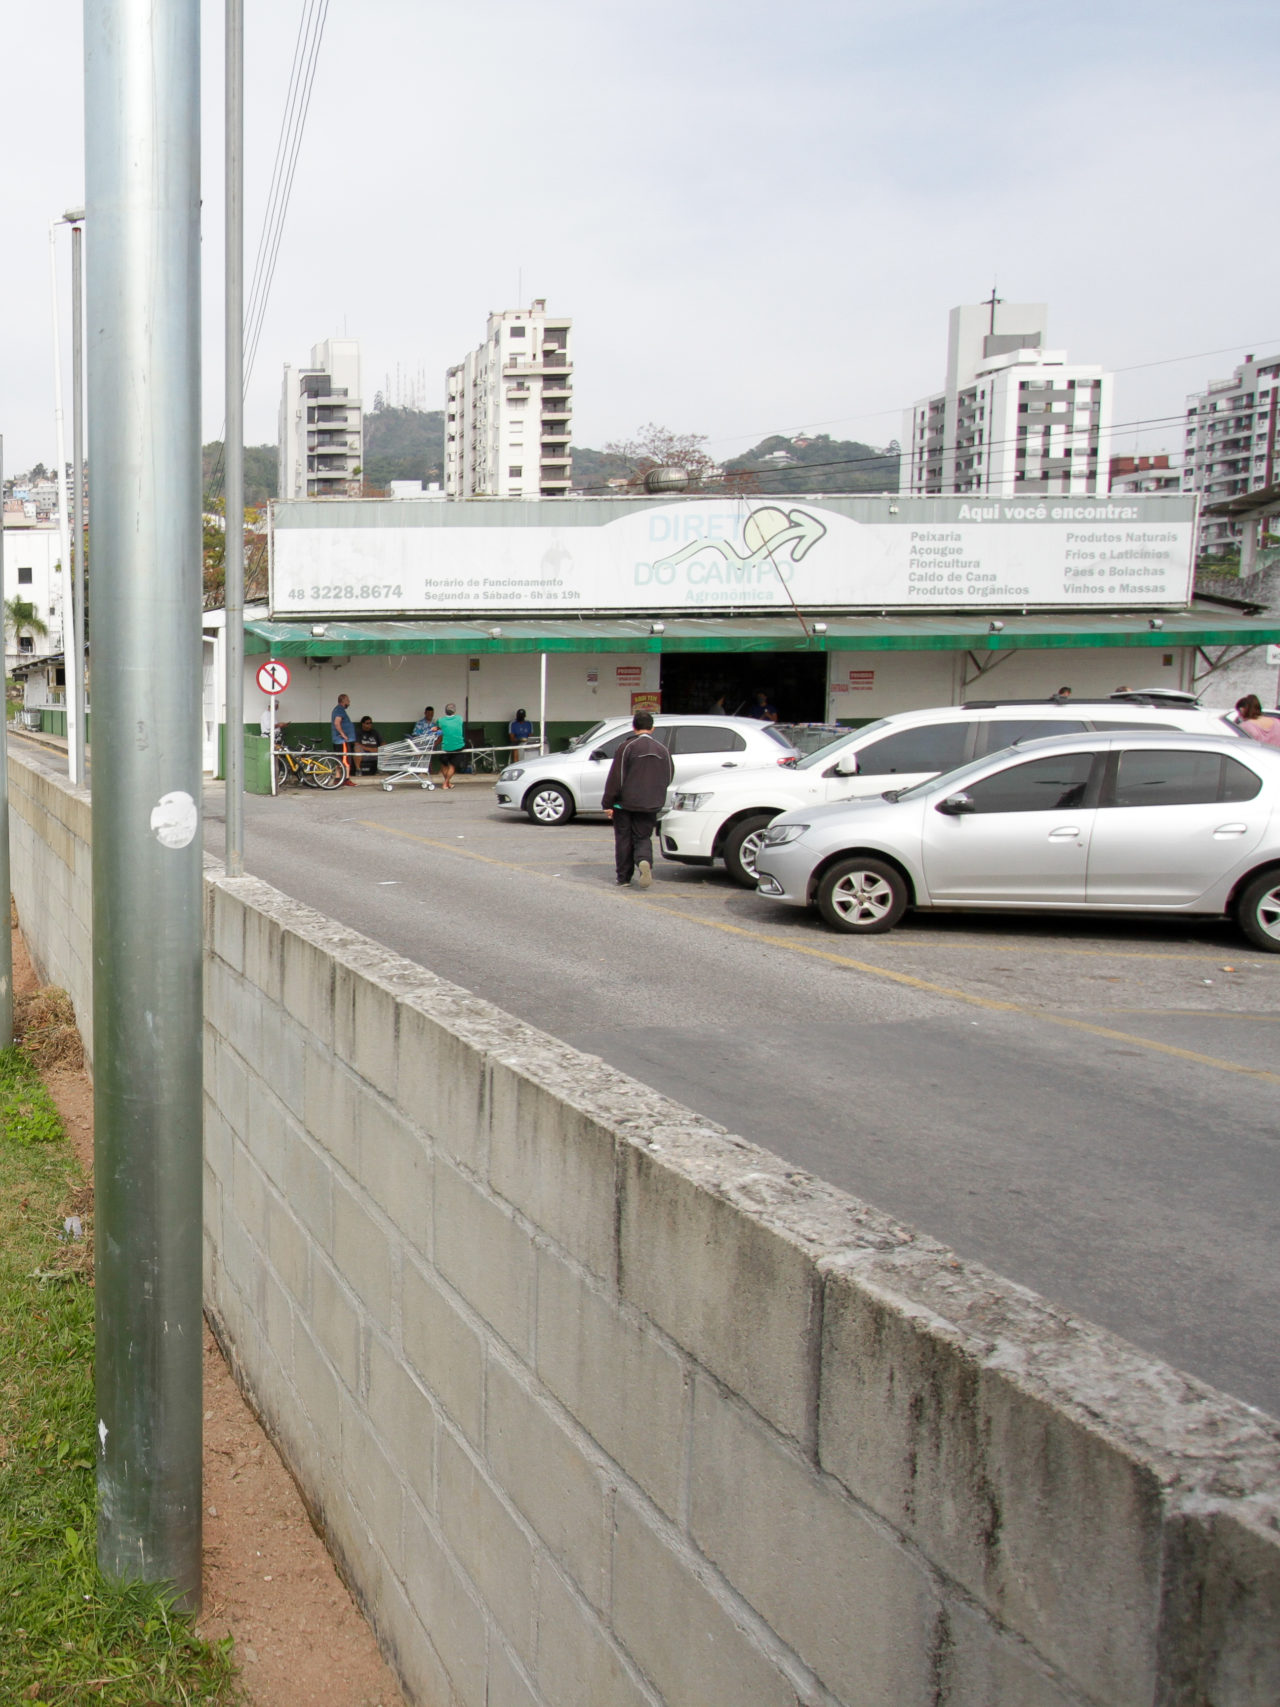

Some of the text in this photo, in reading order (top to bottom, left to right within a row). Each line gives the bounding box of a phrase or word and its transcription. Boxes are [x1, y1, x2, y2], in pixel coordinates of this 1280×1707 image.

[958, 503, 1138, 521] Aqui você encontra:
[911, 531, 962, 542] Peixaria
[1066, 532, 1178, 543] Produtos Naturais
[910, 545, 964, 557] Açougue
[1065, 549, 1096, 560] Frios
[909, 559, 980, 568] Floricultura
[634, 560, 794, 586] DO CAMPO
[1064, 566, 1094, 576] Pães
[1109, 566, 1165, 576] Bolachas
[908, 572, 997, 582] Caldo de Cana
[424, 578, 563, 588] Horário de Funcionamento
[1063, 583, 1166, 594] Vinhos e Massas
[288, 585, 403, 600] 48 3228.8674
[424, 591, 470, 602] Segunda
[482, 591, 521, 600] Sábado
[530, 591, 543, 600] 6h
[562, 591, 580, 599] 19h
[685, 589, 774, 603] Agronômica
[908, 585, 1030, 597] Produtos Orgânicos
